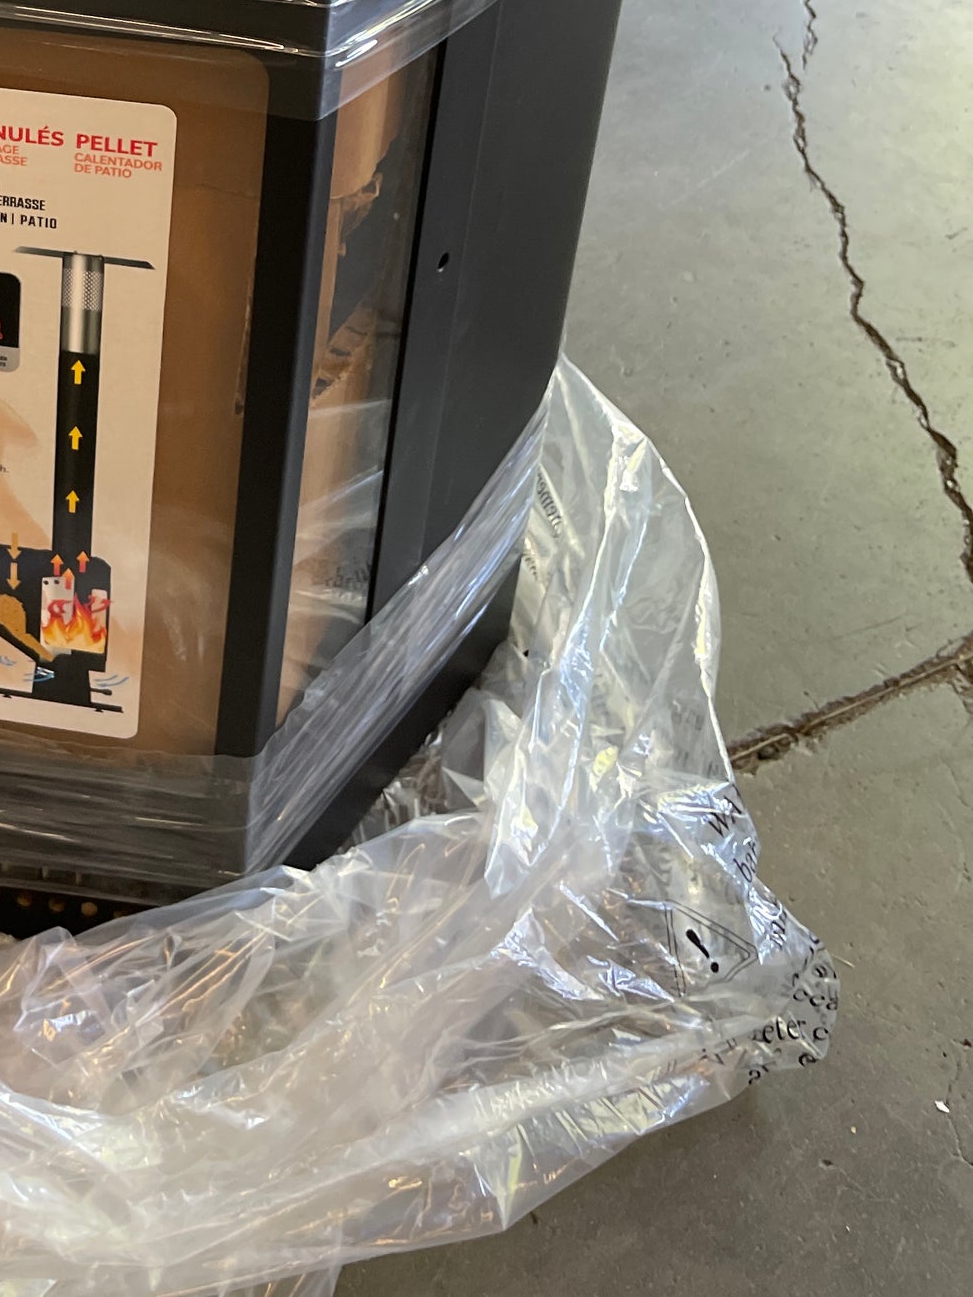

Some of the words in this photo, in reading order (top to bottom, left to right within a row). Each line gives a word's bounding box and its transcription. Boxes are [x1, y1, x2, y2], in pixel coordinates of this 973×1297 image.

[75, 133, 157, 157] PELLET
[73, 152, 162, 171] CALENTADOR
[73, 162, 91, 174] DE
[94, 164, 132, 178] PATIO
[19, 214, 57, 229] PATIO
